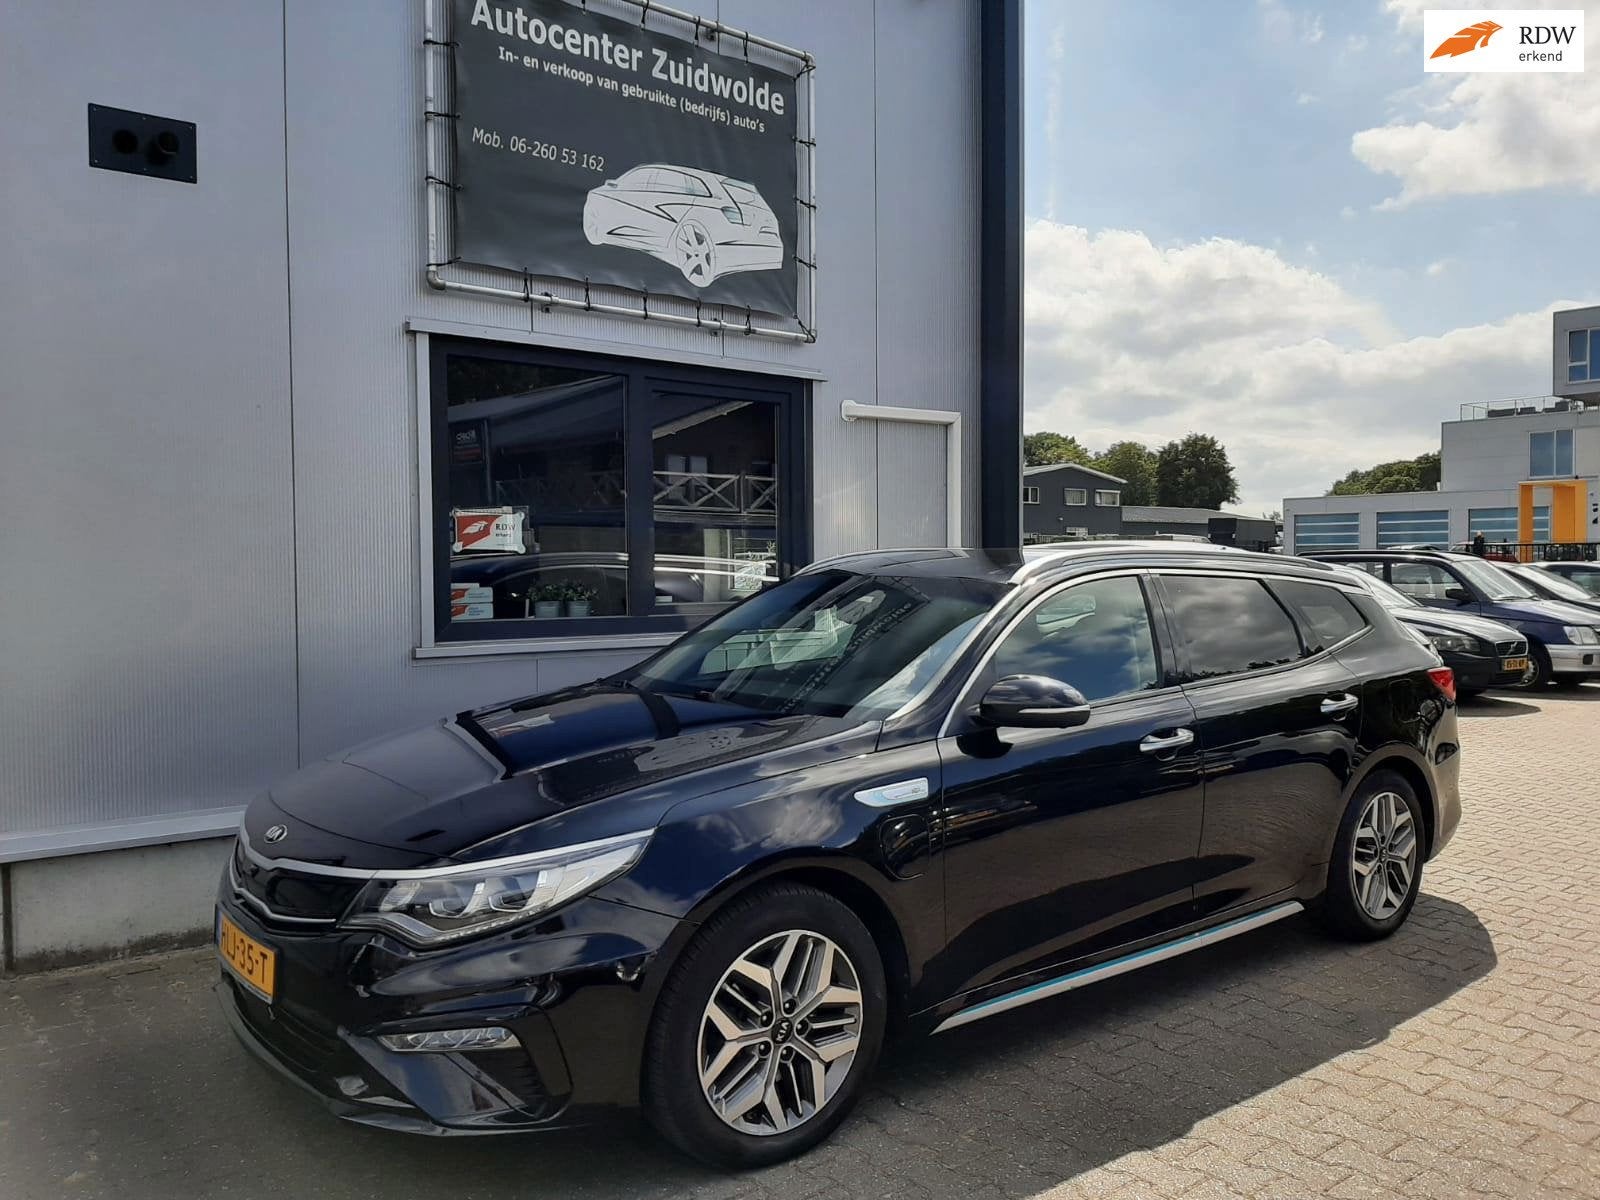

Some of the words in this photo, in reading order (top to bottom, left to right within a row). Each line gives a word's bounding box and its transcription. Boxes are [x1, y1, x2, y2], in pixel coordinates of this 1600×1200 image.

[471, 0, 643, 71] Autocenter
[651, 48, 784, 115] Zuidwolde
[498, 46, 519, 63] In-
[523, 55, 539, 69] en
[543, 60, 593, 86] verkoop
[597, 75, 618, 91] van
[621, 83, 677, 108] gebruikte
[679, 97, 731, 126] (bedrijfs)
[733, 114, 765, 133] auto's
[472, 127, 504, 149] Mob.
[510, 136, 557, 160] 06-260
[561, 148, 577, 165] 53
[582, 153, 605, 171] 162
[495, 523, 515, 531] RDW
[776, 1022, 789, 1042] KIA
